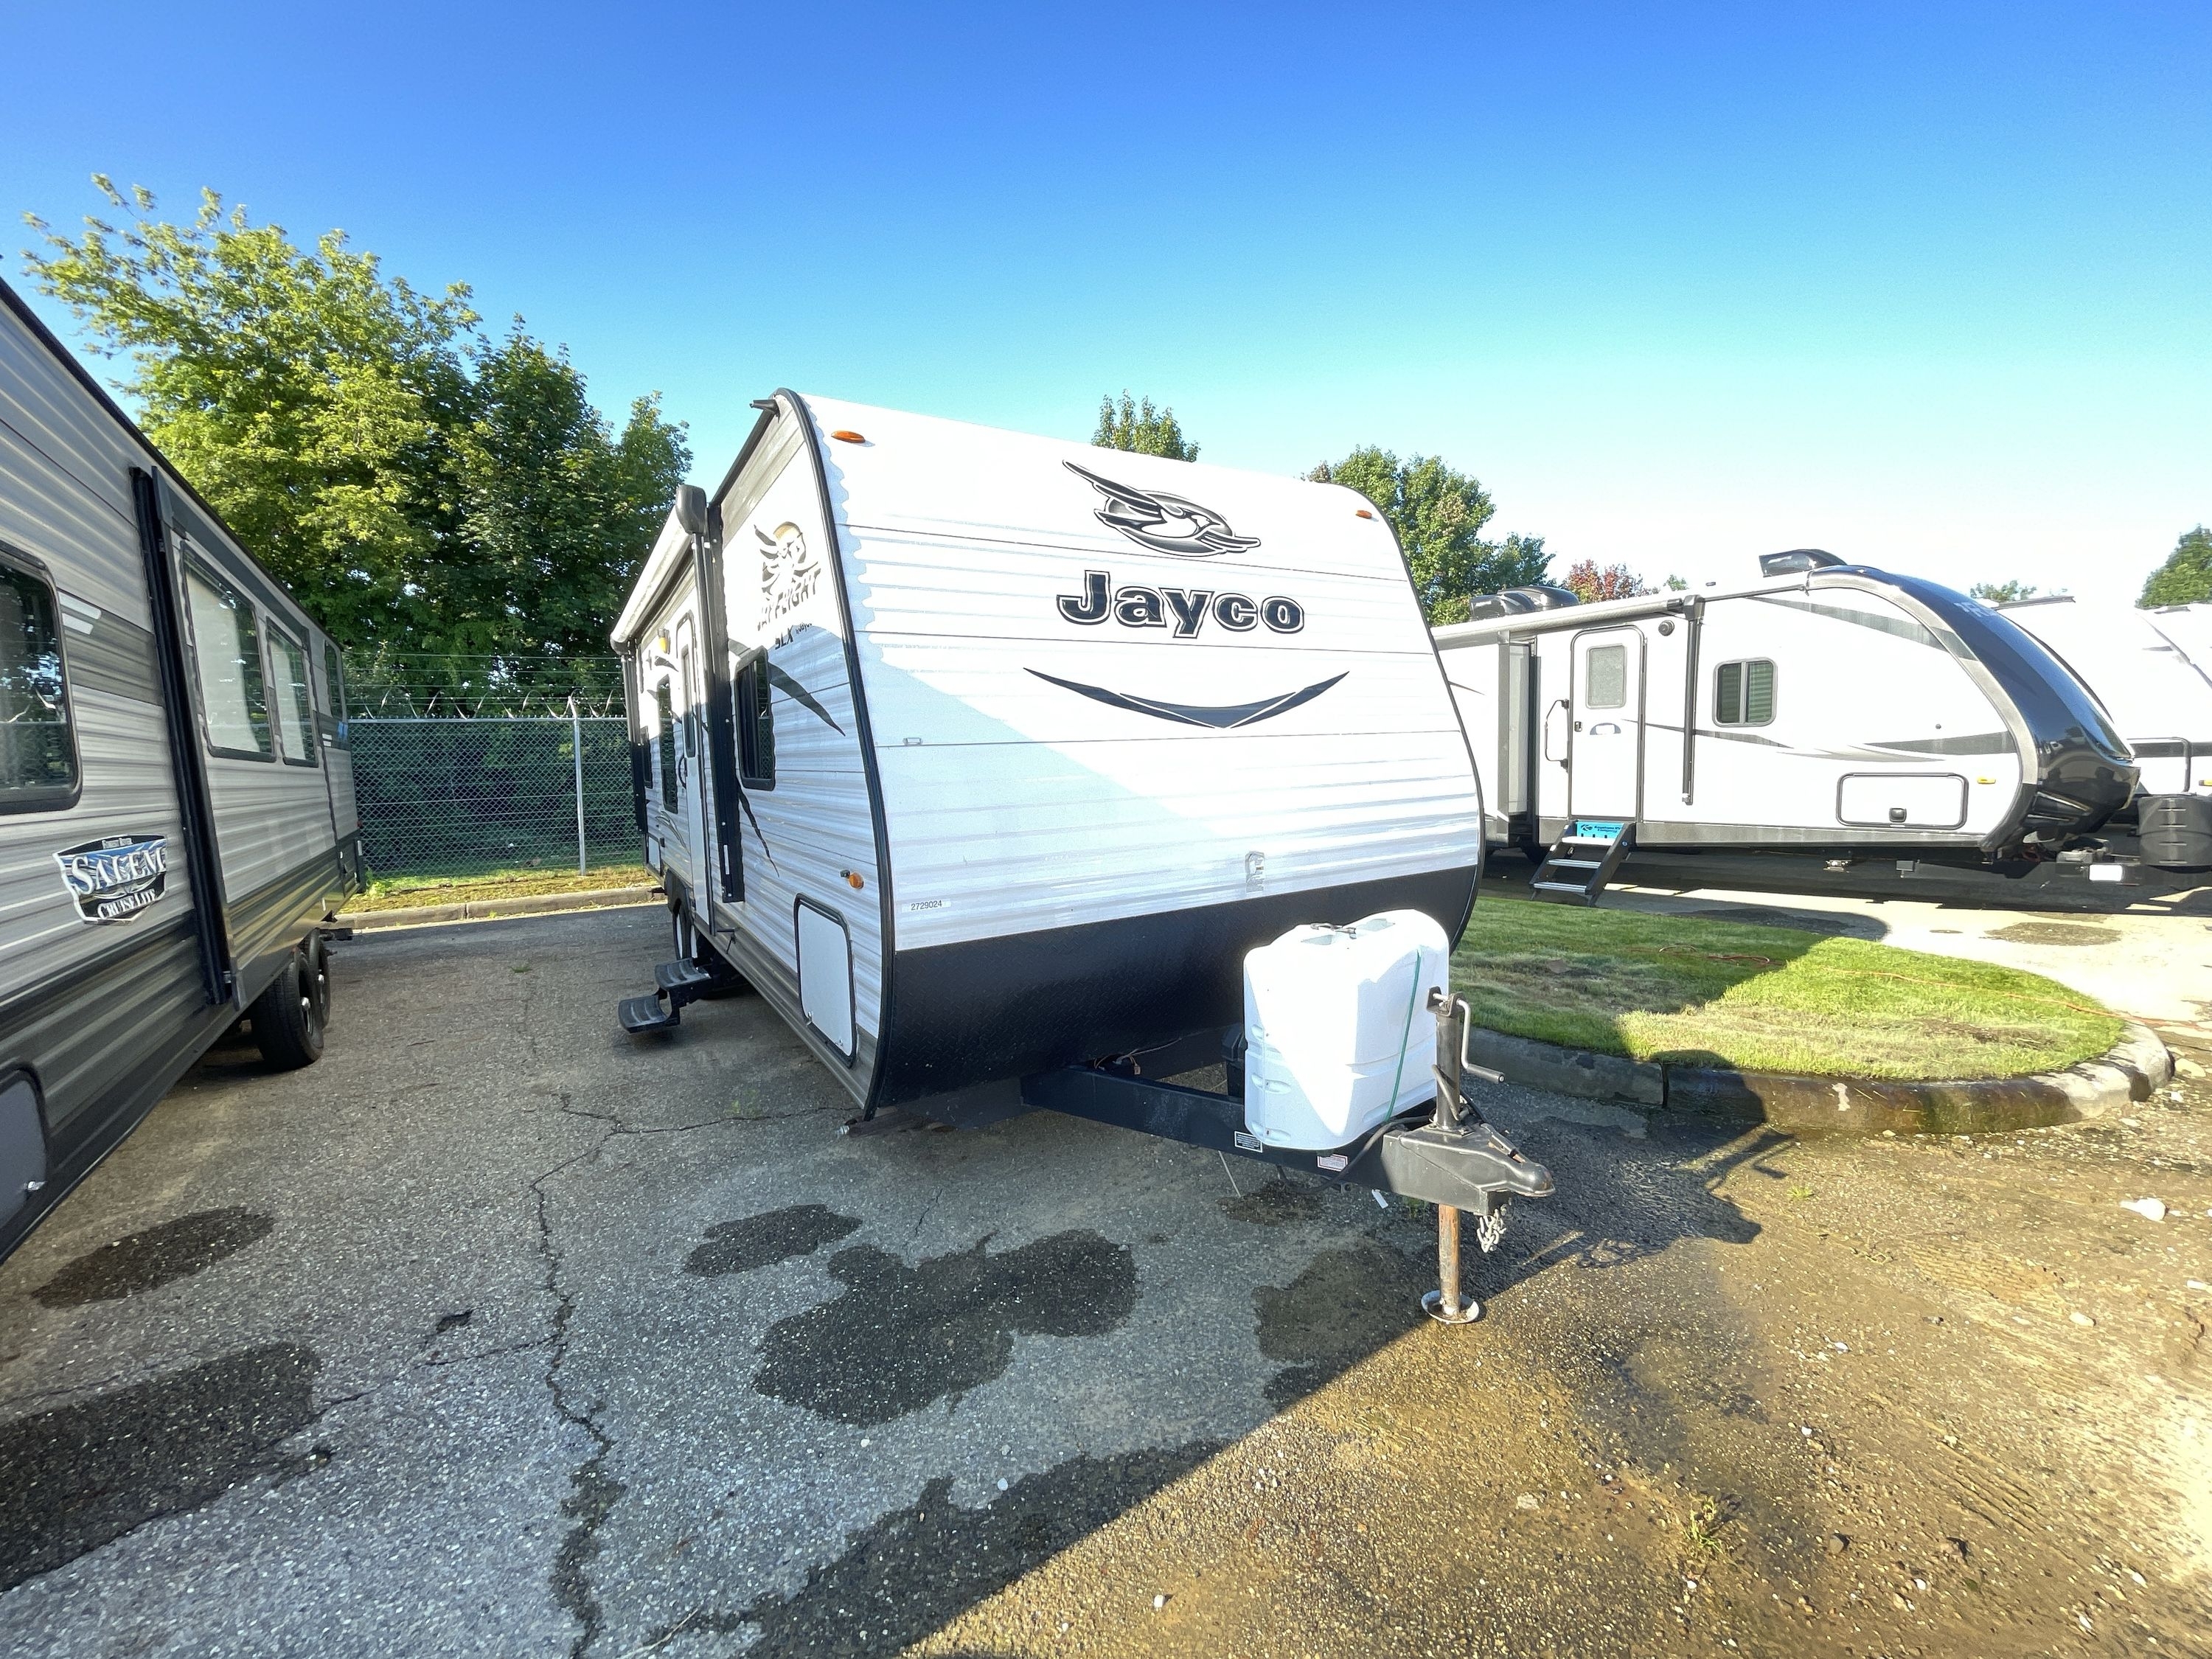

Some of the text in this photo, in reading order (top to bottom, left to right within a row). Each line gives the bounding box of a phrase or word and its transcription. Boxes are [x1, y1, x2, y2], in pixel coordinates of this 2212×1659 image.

[1057, 570, 1304, 639] Jayco
[72, 847, 167, 895] SALEM
[911, 900, 942, 911] 2729024
